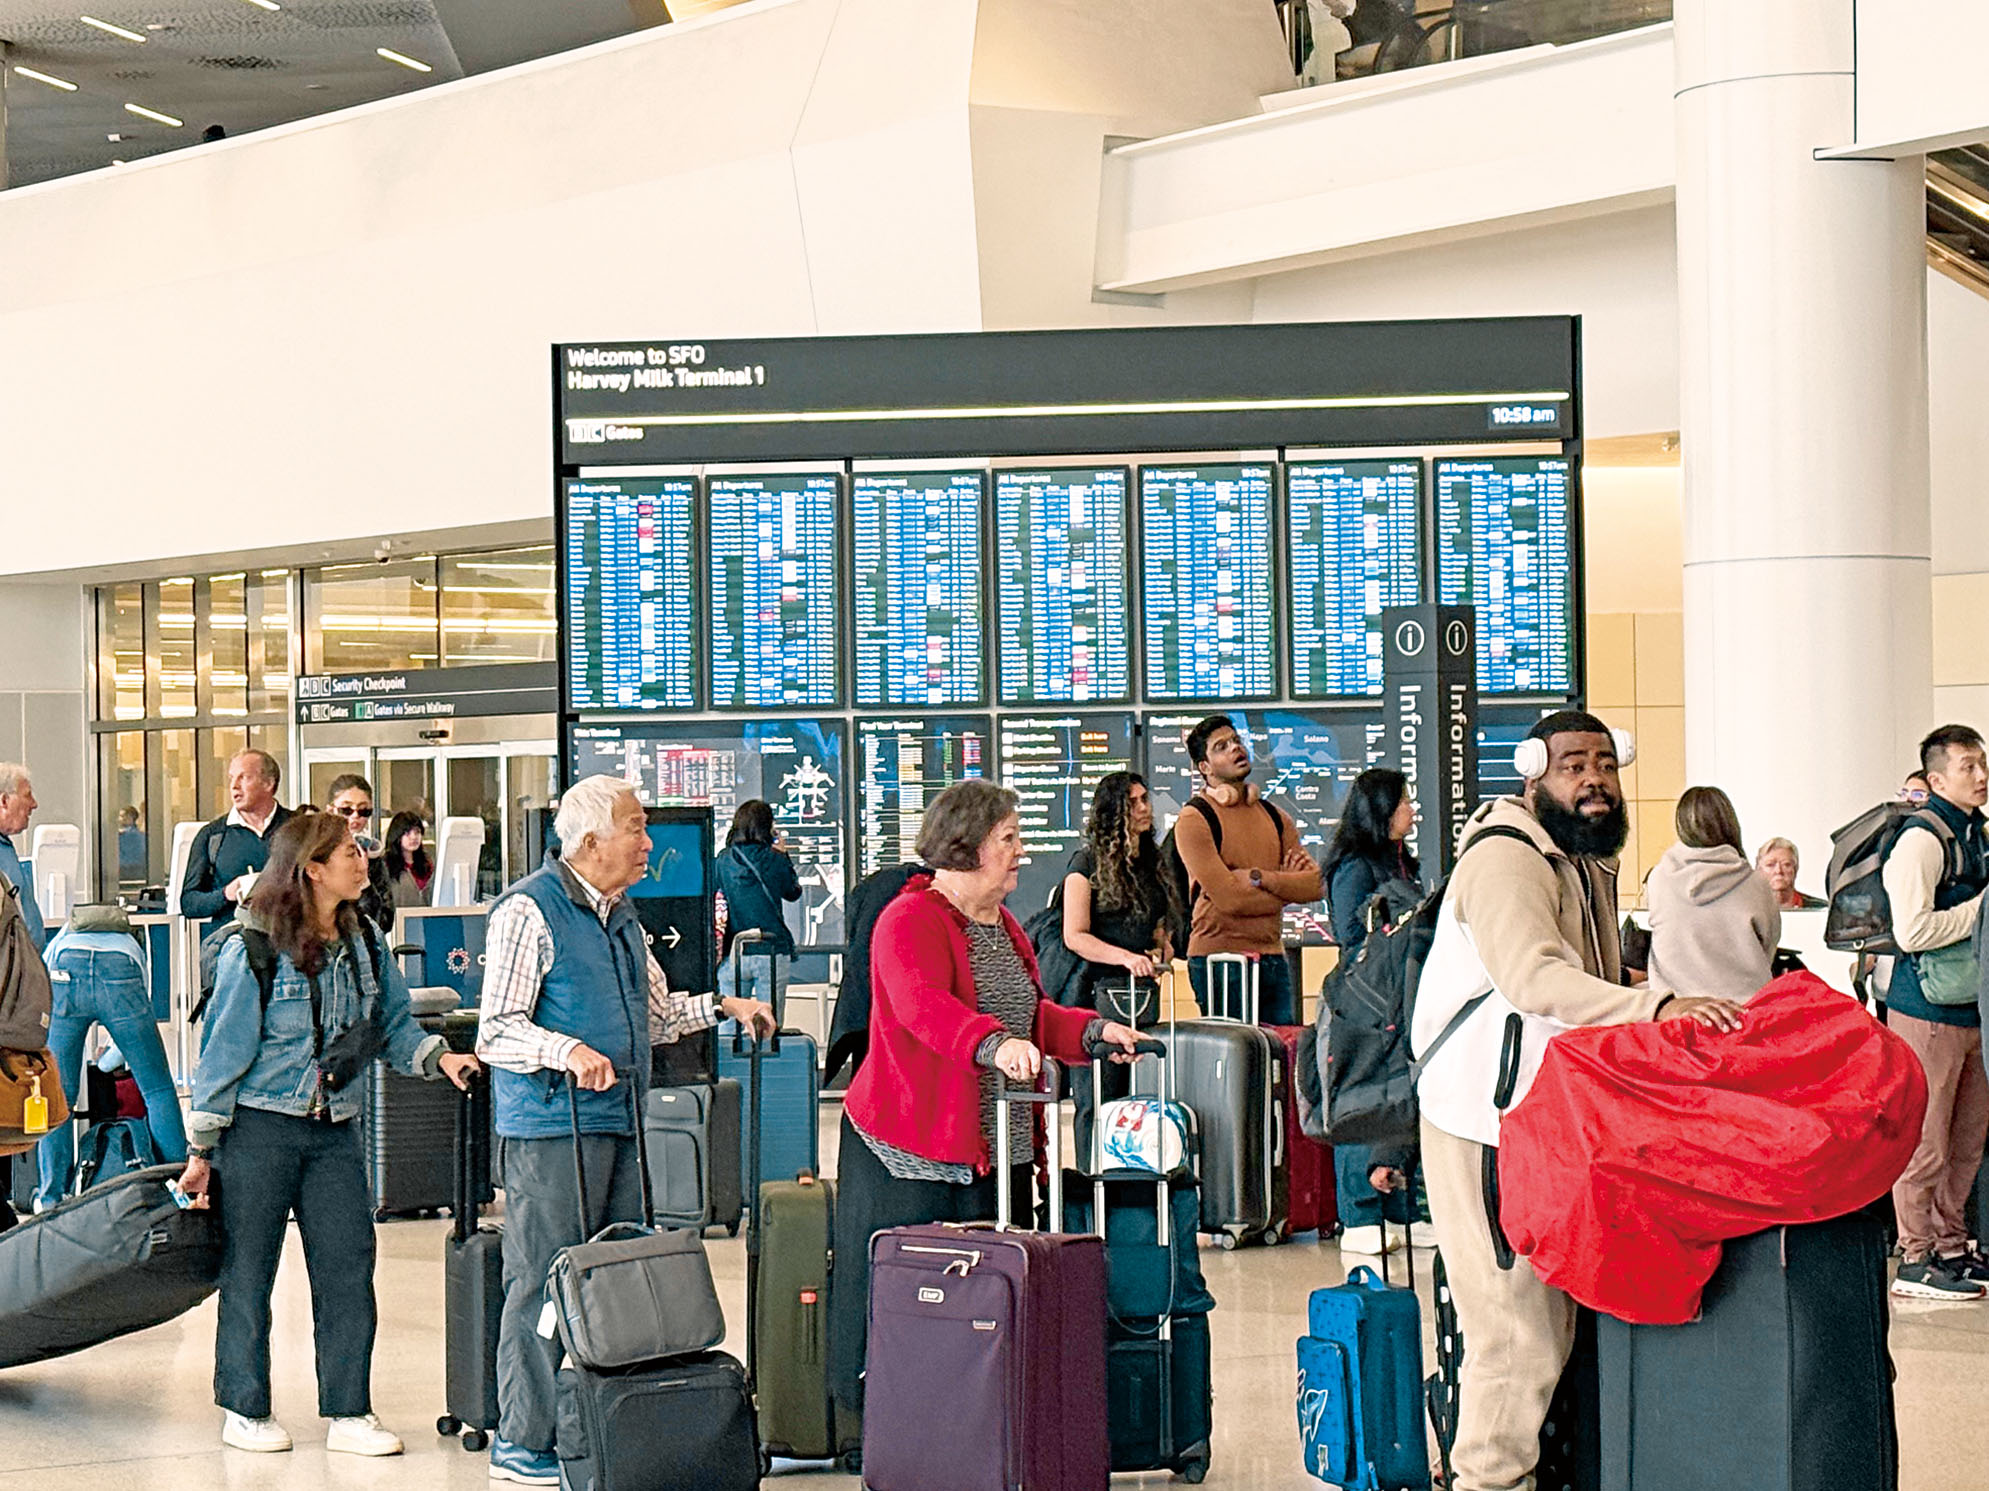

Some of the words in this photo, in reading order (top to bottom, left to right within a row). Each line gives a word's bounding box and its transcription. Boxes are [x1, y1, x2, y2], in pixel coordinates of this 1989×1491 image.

[567, 348, 645, 367] Welcome
[647, 347, 666, 365] to
[668, 345, 706, 365] SFO
[567, 370, 631, 392] Harvey
[633, 368, 674, 388] Milk
[675, 366, 753, 387] Terminal
[754, 365, 765, 385] 1
[1492, 407, 1532, 424] 10:58
[1533, 408, 1555, 422] am
[606, 425, 644, 440] Gates
[332, 678, 363, 694] Security
[364, 676, 406, 693] Checkpoint
[330, 704, 349, 718] Gates
[374, 703, 393, 716] Gates
[394, 703, 403, 715] via
[404, 702, 426, 715] Secure
[426, 701, 455, 715] Walkway
[1303, 735, 1329, 743] Solano
